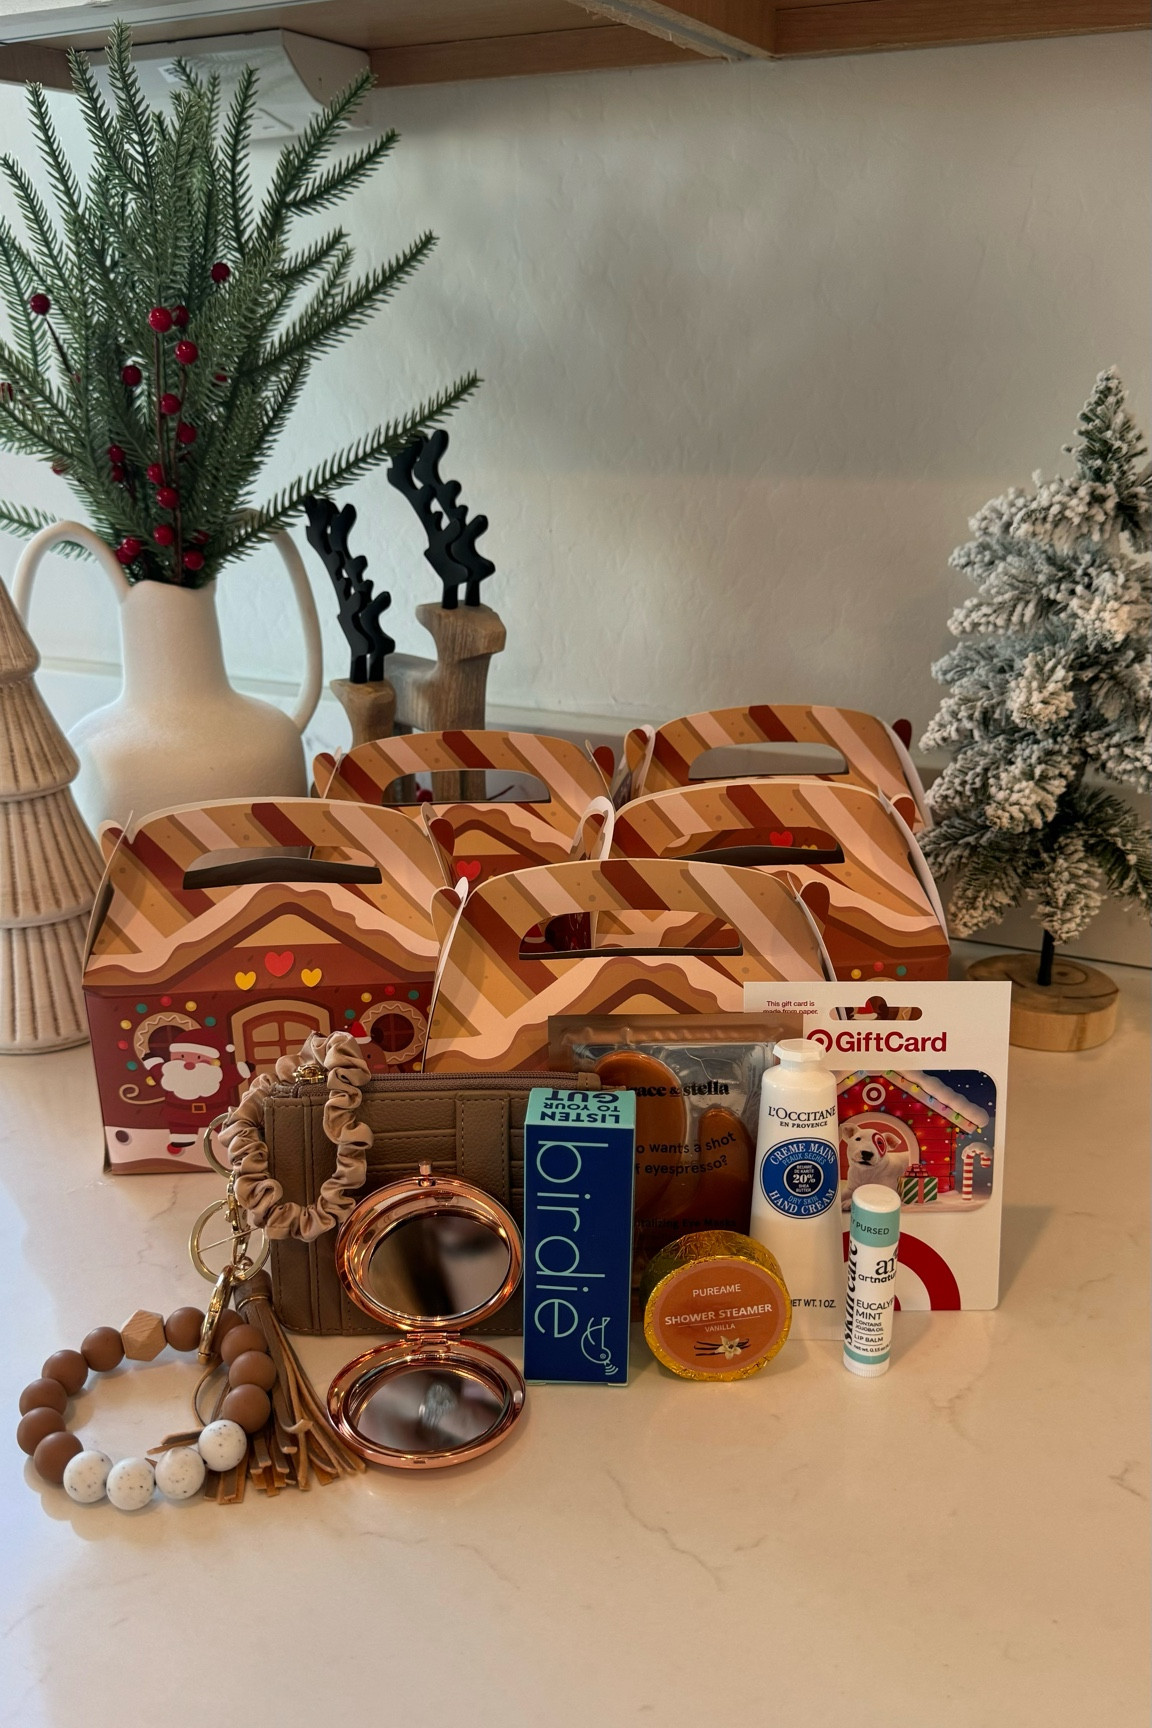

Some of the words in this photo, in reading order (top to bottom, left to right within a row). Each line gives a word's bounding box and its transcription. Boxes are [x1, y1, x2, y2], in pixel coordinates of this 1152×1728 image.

[781, 1000, 792, 1008] gift
[835, 1031, 947, 1053] GiftCard
[631, 1086, 667, 1097] ace
[682, 1080, 730, 1096] stella
[545, 1090, 620, 1104] GUT
[543, 1102, 590, 1111] YOUR
[597, 1105, 620, 1113] TO
[540, 1111, 620, 1124] LISTEN
[792, 1120, 828, 1129] PROVENCE
[649, 1143, 690, 1154] wants
[694, 1144, 703, 1153] a
[705, 1131, 736, 1151] shot
[781, 1152, 803, 1166] PEAUX
[809, 1142, 836, 1164] MAINS
[644, 1154, 729, 1177] eyespresso?
[792, 1173, 816, 1184] 20%
[769, 1190, 798, 1214] HAND
[801, 1189, 835, 1214] CREAM
[788, 1195, 801, 1205] DRY
[803, 1195, 818, 1206] SKIN
[856, 1221, 890, 1235] PURSED
[534, 1140, 609, 1338] birdie
[692, 1284, 741, 1298] PUREAME
[803, 1298, 817, 1307] WT.
[665, 1312, 716, 1325] SHOWER
[718, 1304, 773, 1318] STEAMER
[856, 1309, 882, 1320] MINT
[704, 1323, 736, 1333] VANILLA
[855, 1319, 882, 1327] CONTAINS
